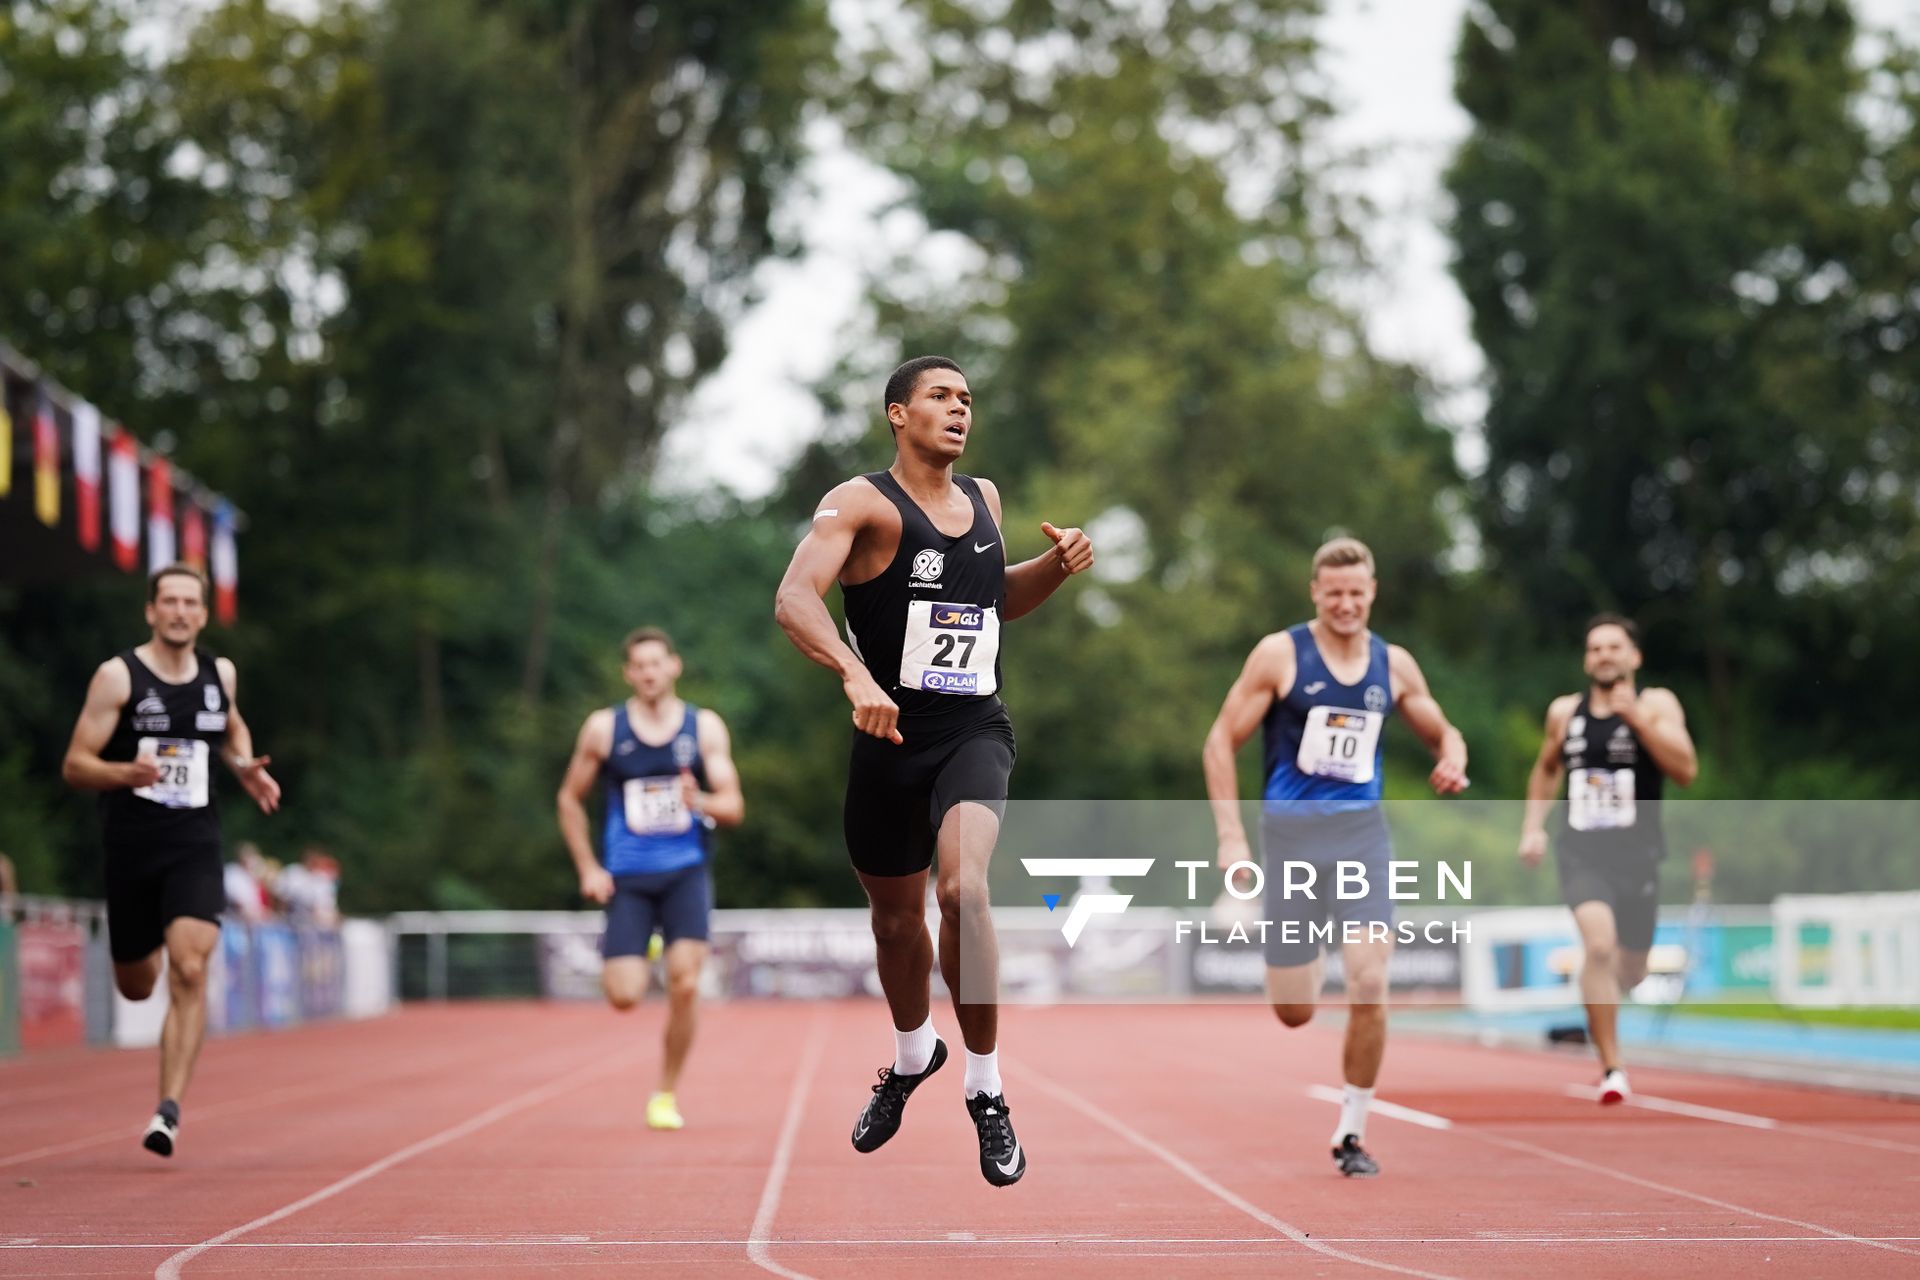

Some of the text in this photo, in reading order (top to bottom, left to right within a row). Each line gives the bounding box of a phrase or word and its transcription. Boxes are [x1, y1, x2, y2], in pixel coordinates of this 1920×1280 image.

[911, 550, 945, 580] 96
[960, 612, 980, 626] GLS
[931, 633, 977, 669] 27
[946, 676, 976, 687] PLAN
[1328, 735, 1357, 759] 10
[159, 764, 188, 786] 28
